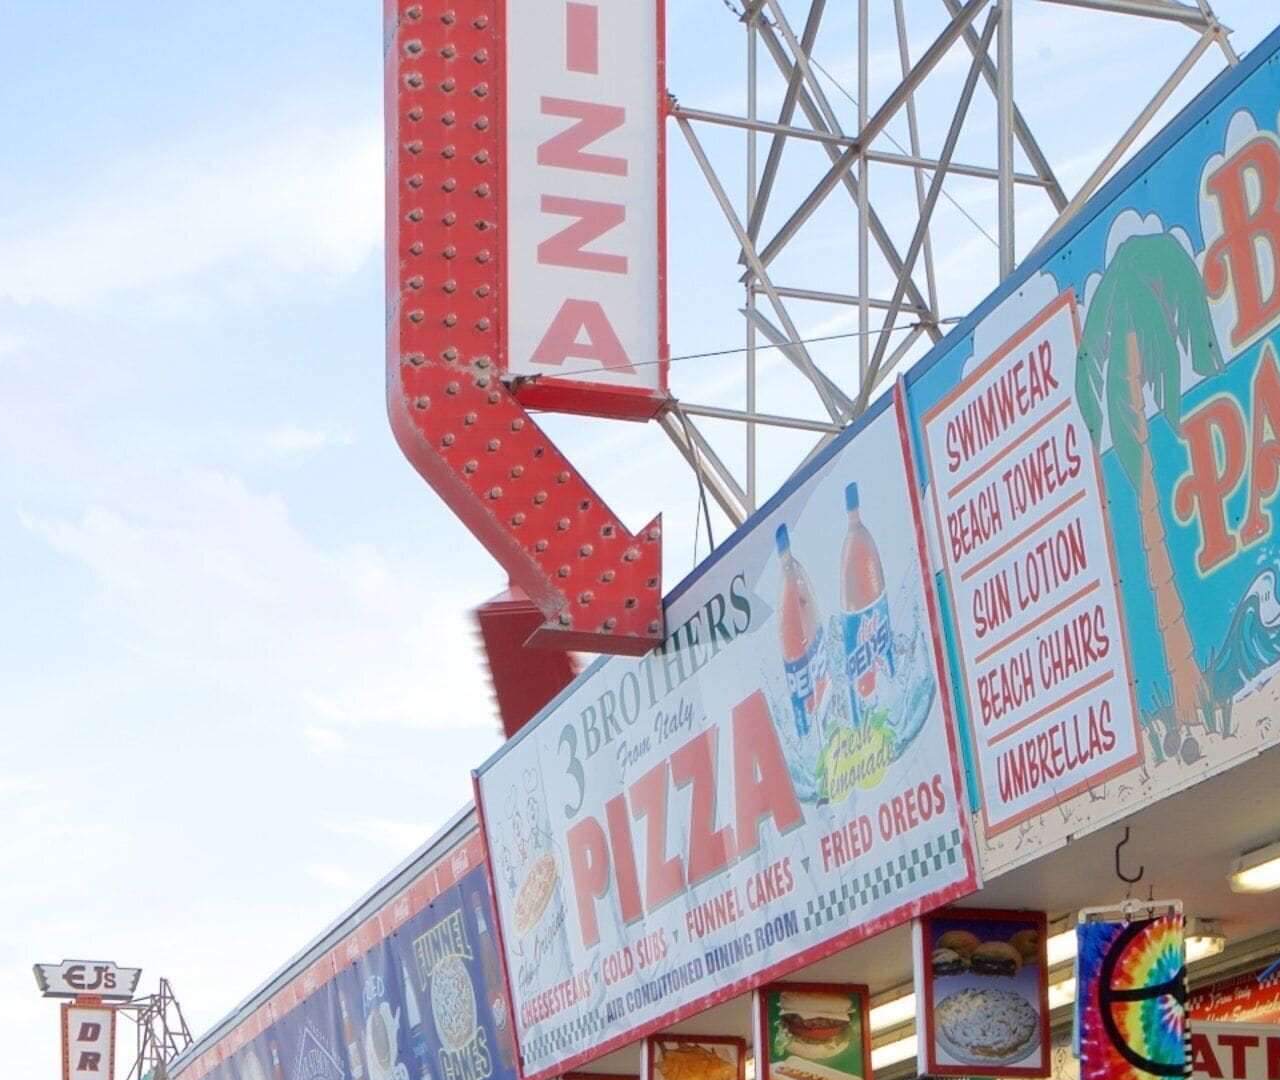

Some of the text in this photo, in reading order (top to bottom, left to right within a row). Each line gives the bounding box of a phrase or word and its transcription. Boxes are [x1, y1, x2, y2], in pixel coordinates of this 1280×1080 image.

[946, 340, 1059, 472] SWIMWEAR
[947, 424, 1081, 565] BEACH TOWELS
[973, 519, 1087, 638] SUN LOTION
[557, 569, 752, 820] 3 BROTHERS
[654, 698, 695, 745] Italy
[978, 605, 1110, 726] BEACH CHAIRS
[828, 709, 873, 773] Fresh
[996, 699, 1115, 804] UMBRELLAS
[566, 688, 806, 952] PIZZA
[820, 774, 946, 873] FRIED OREOS
[63, 965, 116, 990] EJ's
[413, 908, 474, 990] FUNNEL
[520, 857, 795, 1029] CHEESESTEAKS COLD SUBS FUNNEL CAKES
[606, 910, 800, 1024] AIR CONDITIONED DINING ROOM
